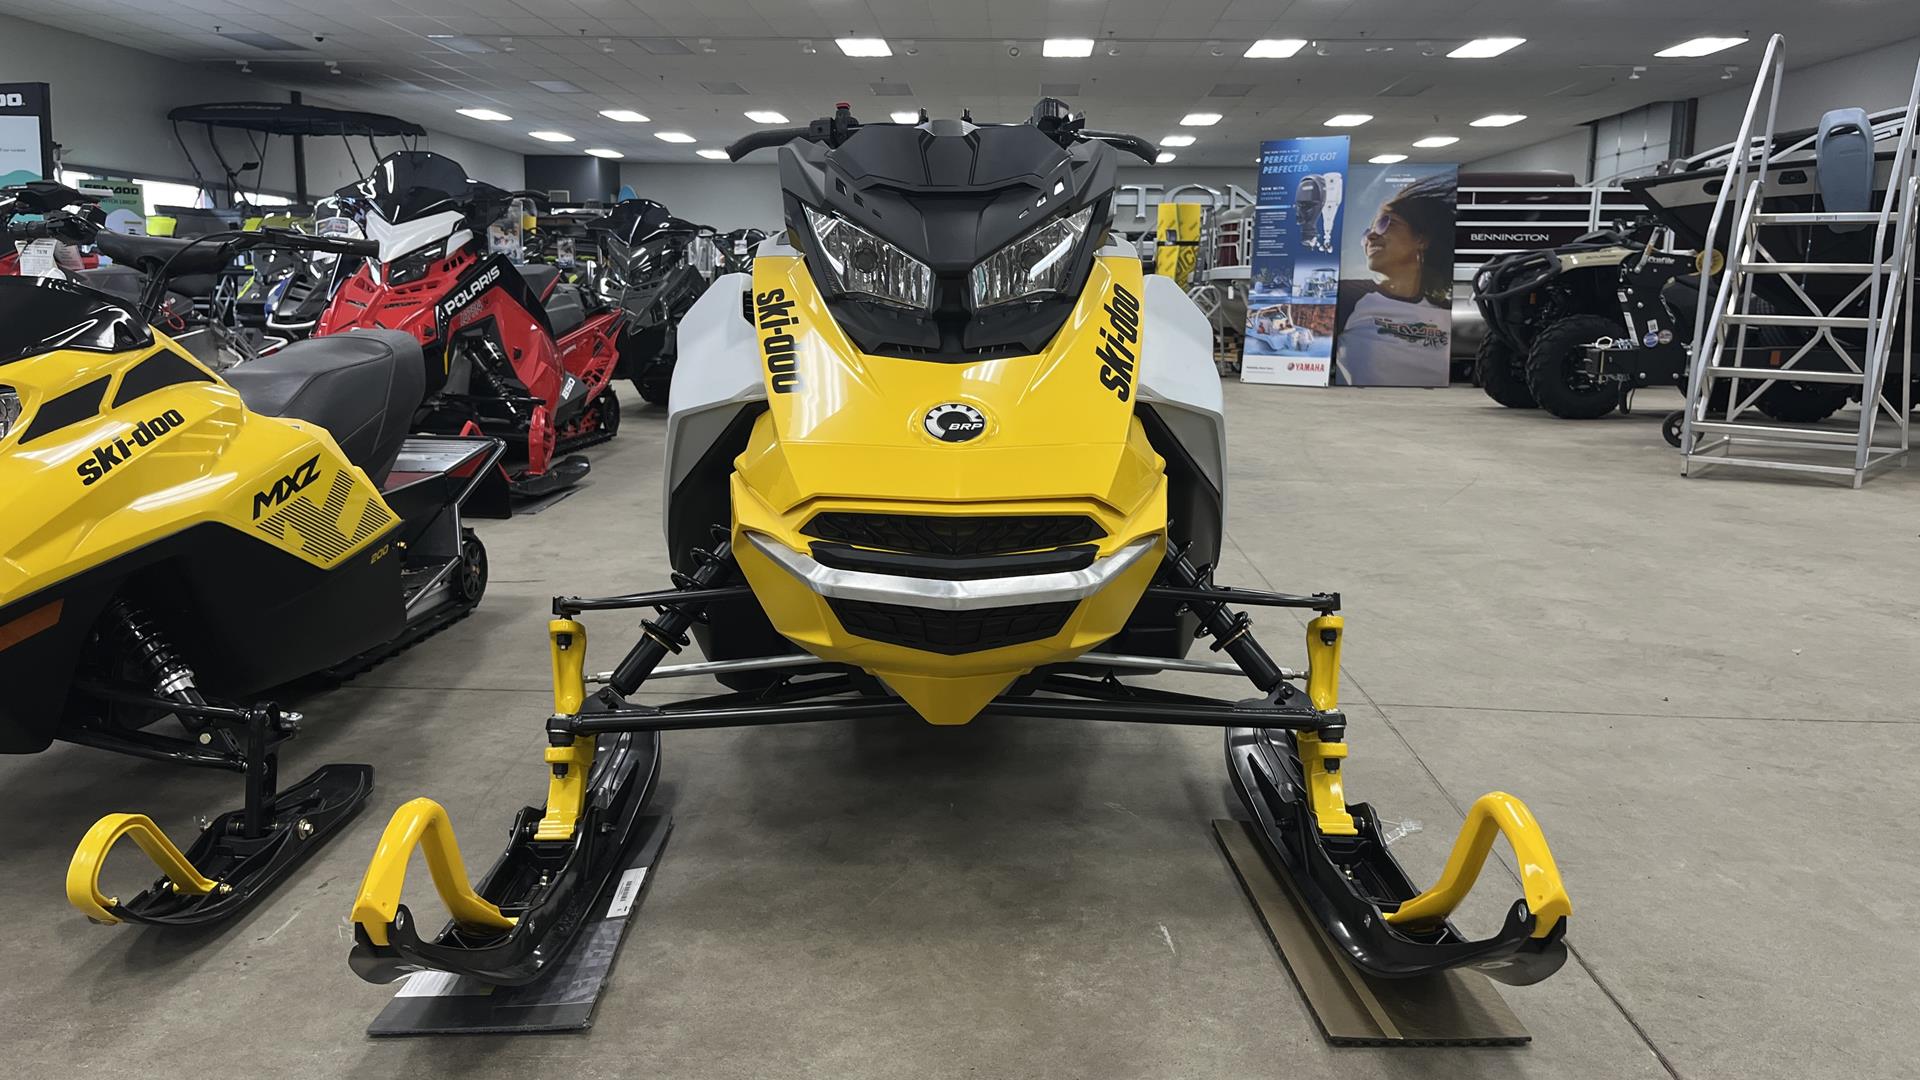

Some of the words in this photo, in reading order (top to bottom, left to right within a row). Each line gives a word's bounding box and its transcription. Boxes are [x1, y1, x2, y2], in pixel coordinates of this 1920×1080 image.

[1263, 154, 1299, 164] PERFECT
[1300, 152, 1319, 164] JUST
[1320, 151, 1337, 160] GOT
[1470, 233, 1549, 241] BENNINGTON
[444, 265, 501, 316] POLARIS
[757, 288, 801, 394] ski-doo
[1095, 283, 1140, 402] ski-doo
[1295, 363, 1325, 372] YAMAHA
[948, 423, 983, 431] BRP
[76, 409, 185, 486] ski-doo
[252, 453, 321, 520] MXZ
[370, 543, 389, 564] 200
